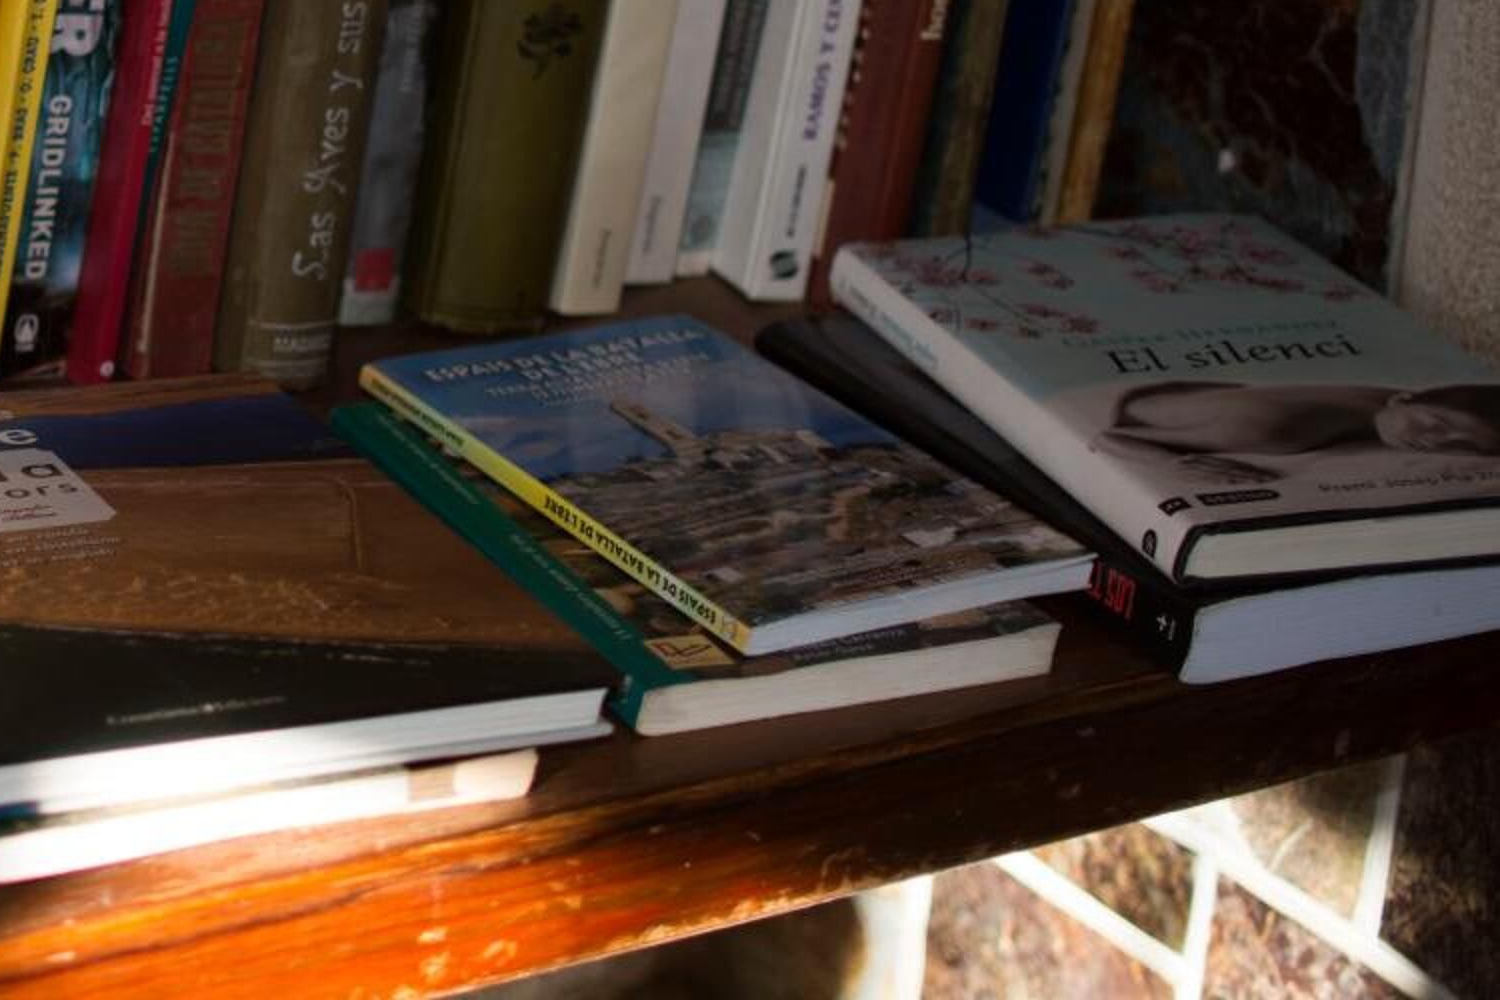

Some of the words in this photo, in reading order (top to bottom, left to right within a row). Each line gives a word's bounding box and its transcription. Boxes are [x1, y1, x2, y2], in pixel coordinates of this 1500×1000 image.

[338, 1, 368, 55] sus
[329, 69, 365, 94] y
[24, 94, 74, 280] GRIDLINKED
[1107, 346, 1170, 375] El
[1183, 333, 1363, 370] silenci
[594, 530, 645, 577] BATALLA
